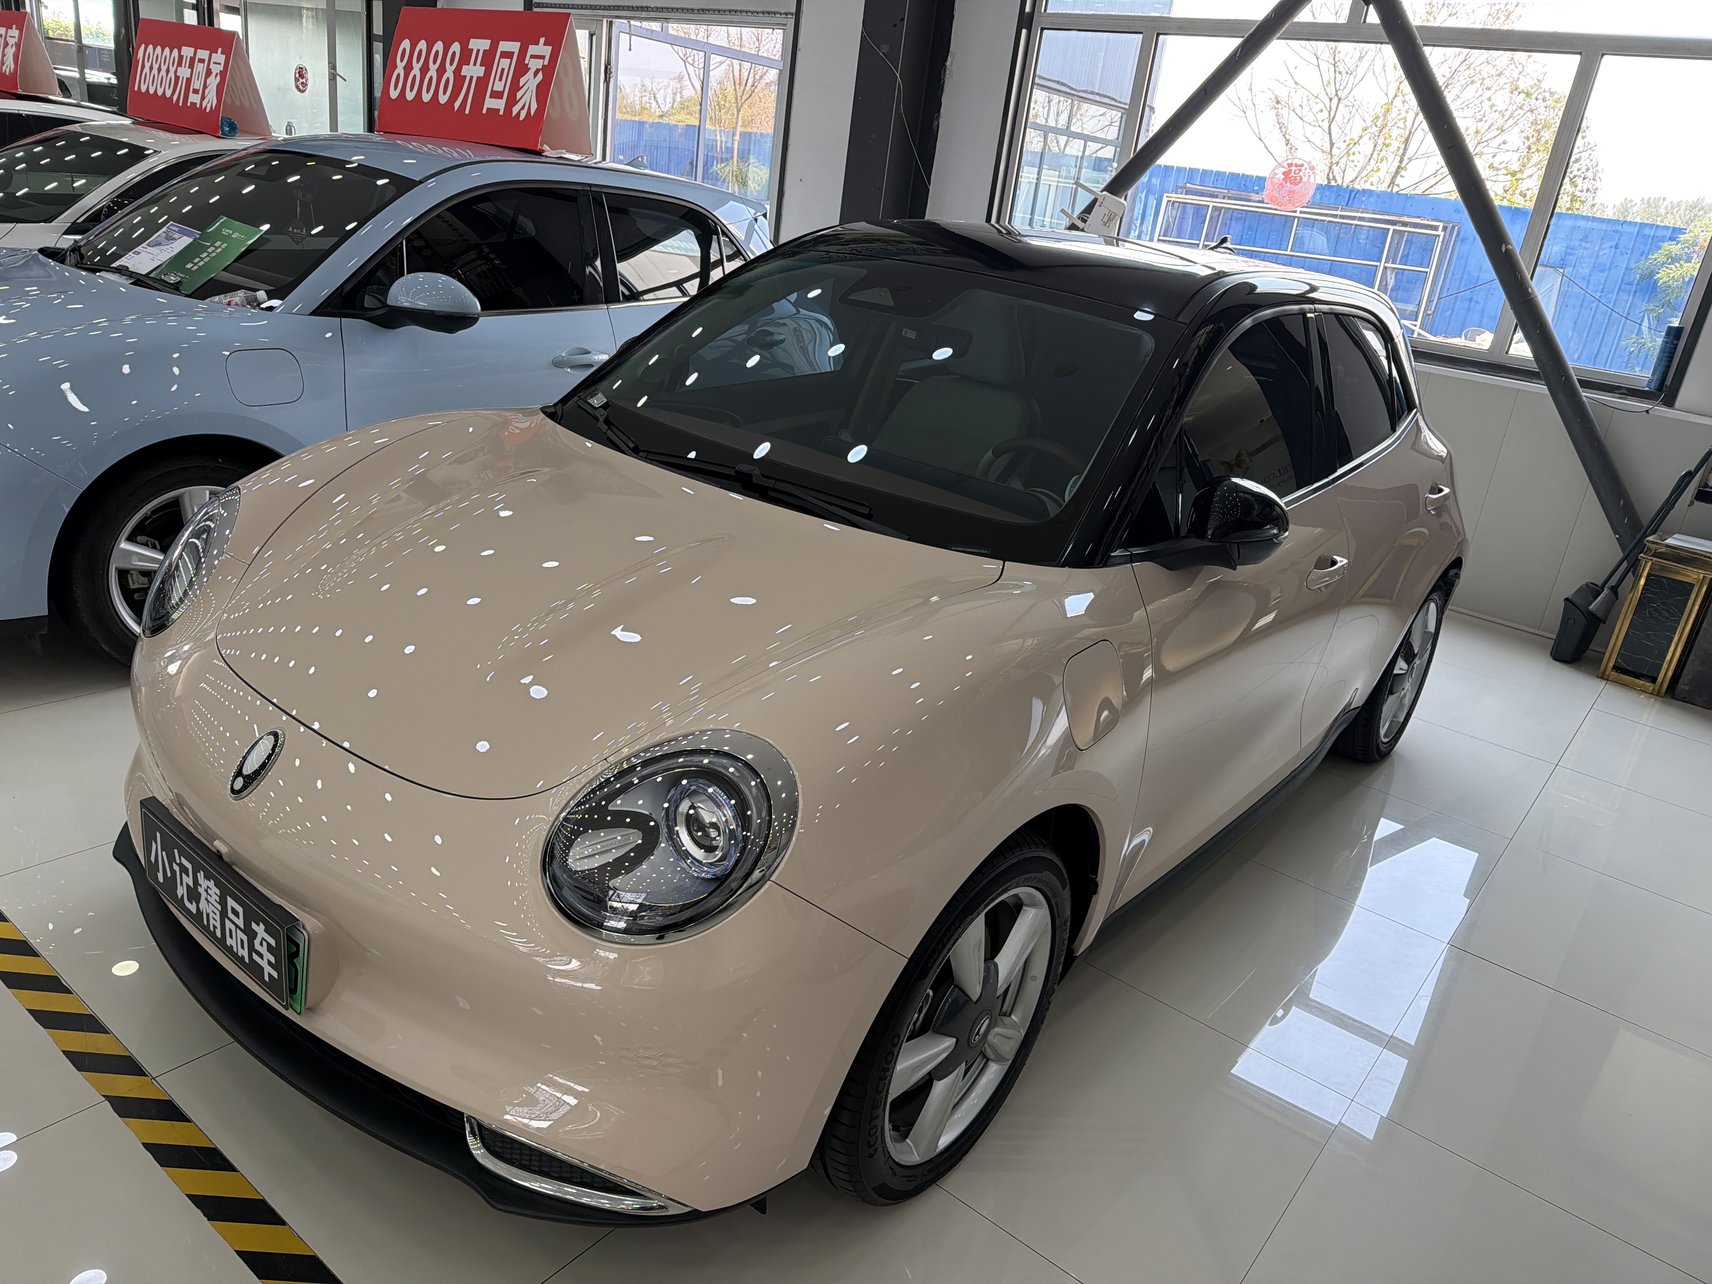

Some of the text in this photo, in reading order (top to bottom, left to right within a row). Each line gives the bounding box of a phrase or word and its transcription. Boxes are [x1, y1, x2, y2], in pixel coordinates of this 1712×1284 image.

[134, 43, 226, 113] 18888开回家
[389, 37, 552, 121] 8888开回家
[1281, 162, 1304, 187] 福
[150, 831, 278, 982] 小记精品车
